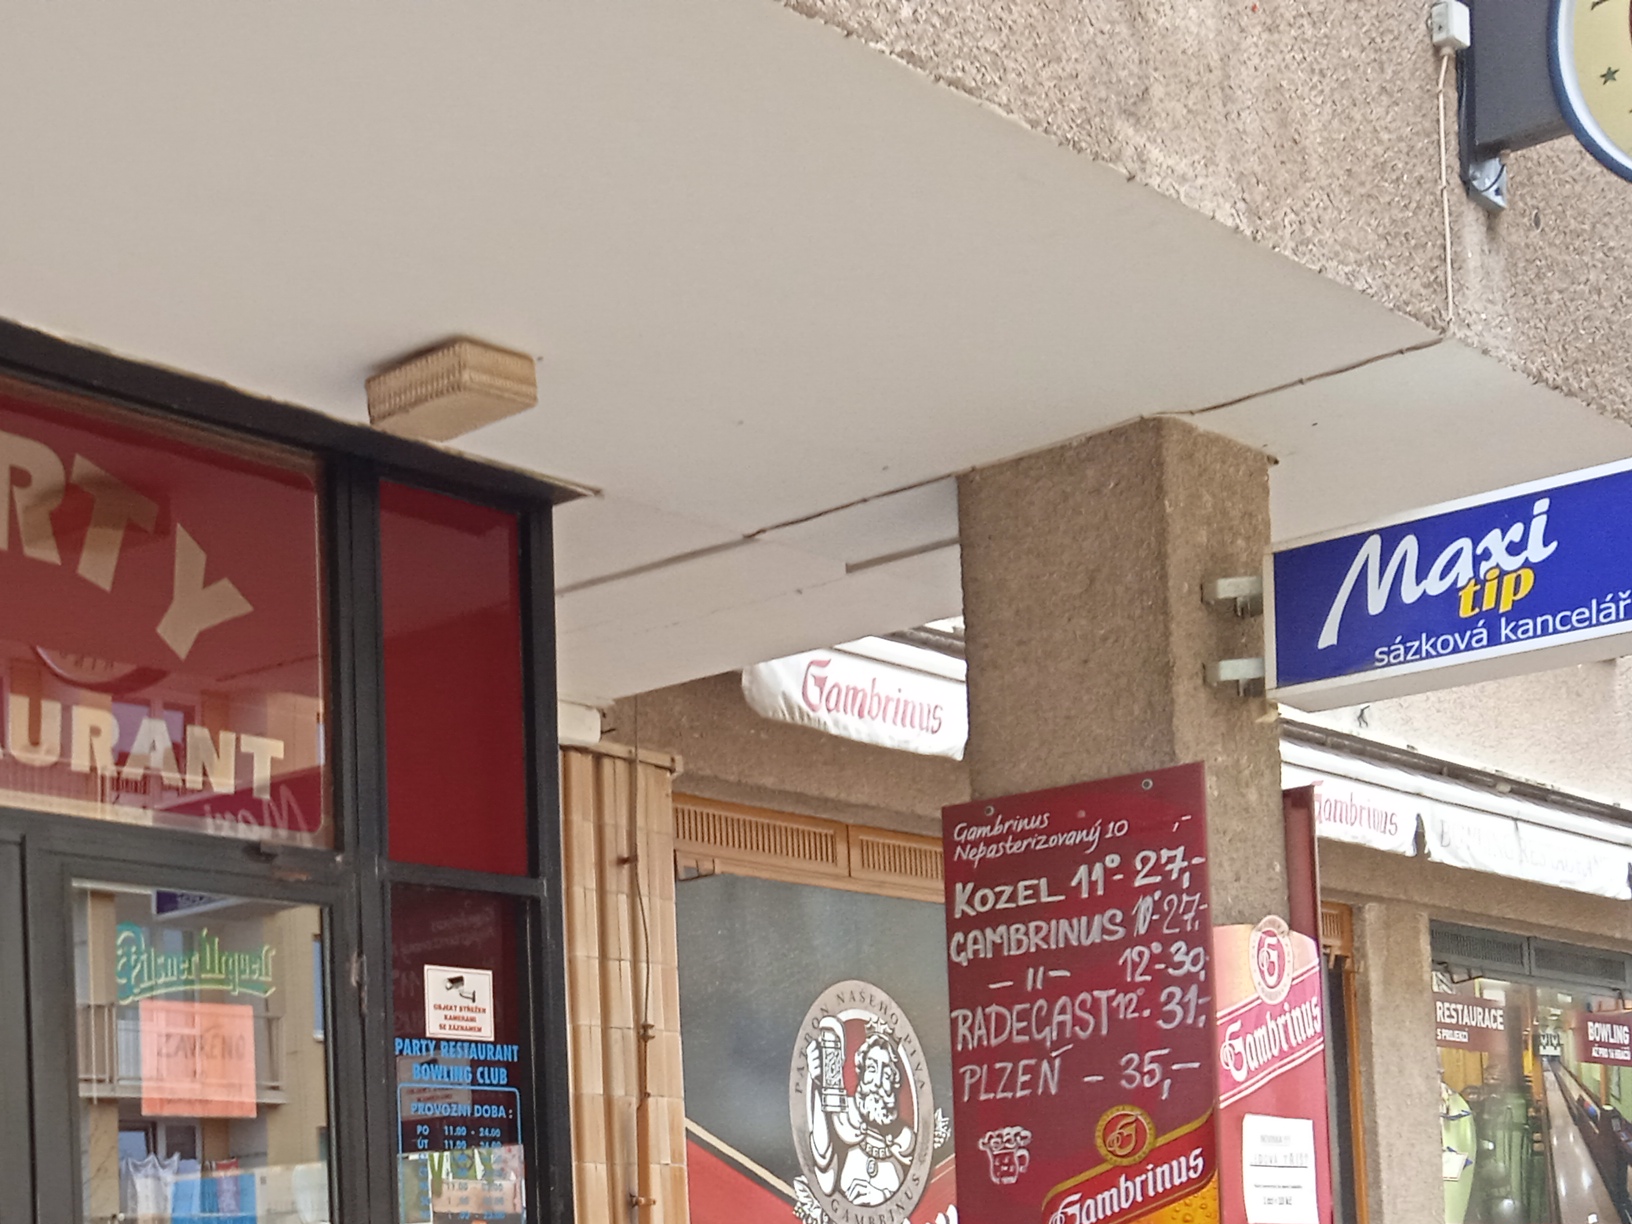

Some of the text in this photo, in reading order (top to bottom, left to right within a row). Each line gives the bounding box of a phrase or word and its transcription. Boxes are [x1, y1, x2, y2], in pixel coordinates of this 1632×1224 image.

[1317, 497, 1559, 650] Maxi
[1457, 566, 1535, 619] tip
[1374, 591, 1632, 668] sázková kancelář
[801, 658, 944, 735] Gambrinus
[953, 812, 1051, 843] Gambrinus
[953, 818, 1103, 868] Nepasterizovaný
[1104, 819, 1129, 839] 10
[953, 876, 1067, 919] KOZEL
[950, 908, 1127, 967] GAMBRINUS
[836, 987, 900, 1025] NAŠEHO
[902, 1032, 926, 1090] PIVA
[951, 988, 1117, 1052] RADEGAST
[1221, 996, 1322, 1082] Gambrinus
[1435, 1000, 1506, 1031] RESTAURACE
[1587, 1020, 1631, 1045] BOWLING
[394, 1038, 519, 1062] PARTY RESTAURANT
[413, 1063, 508, 1084] BOWLING CLUB
[416, 1124, 430, 1135] PO
